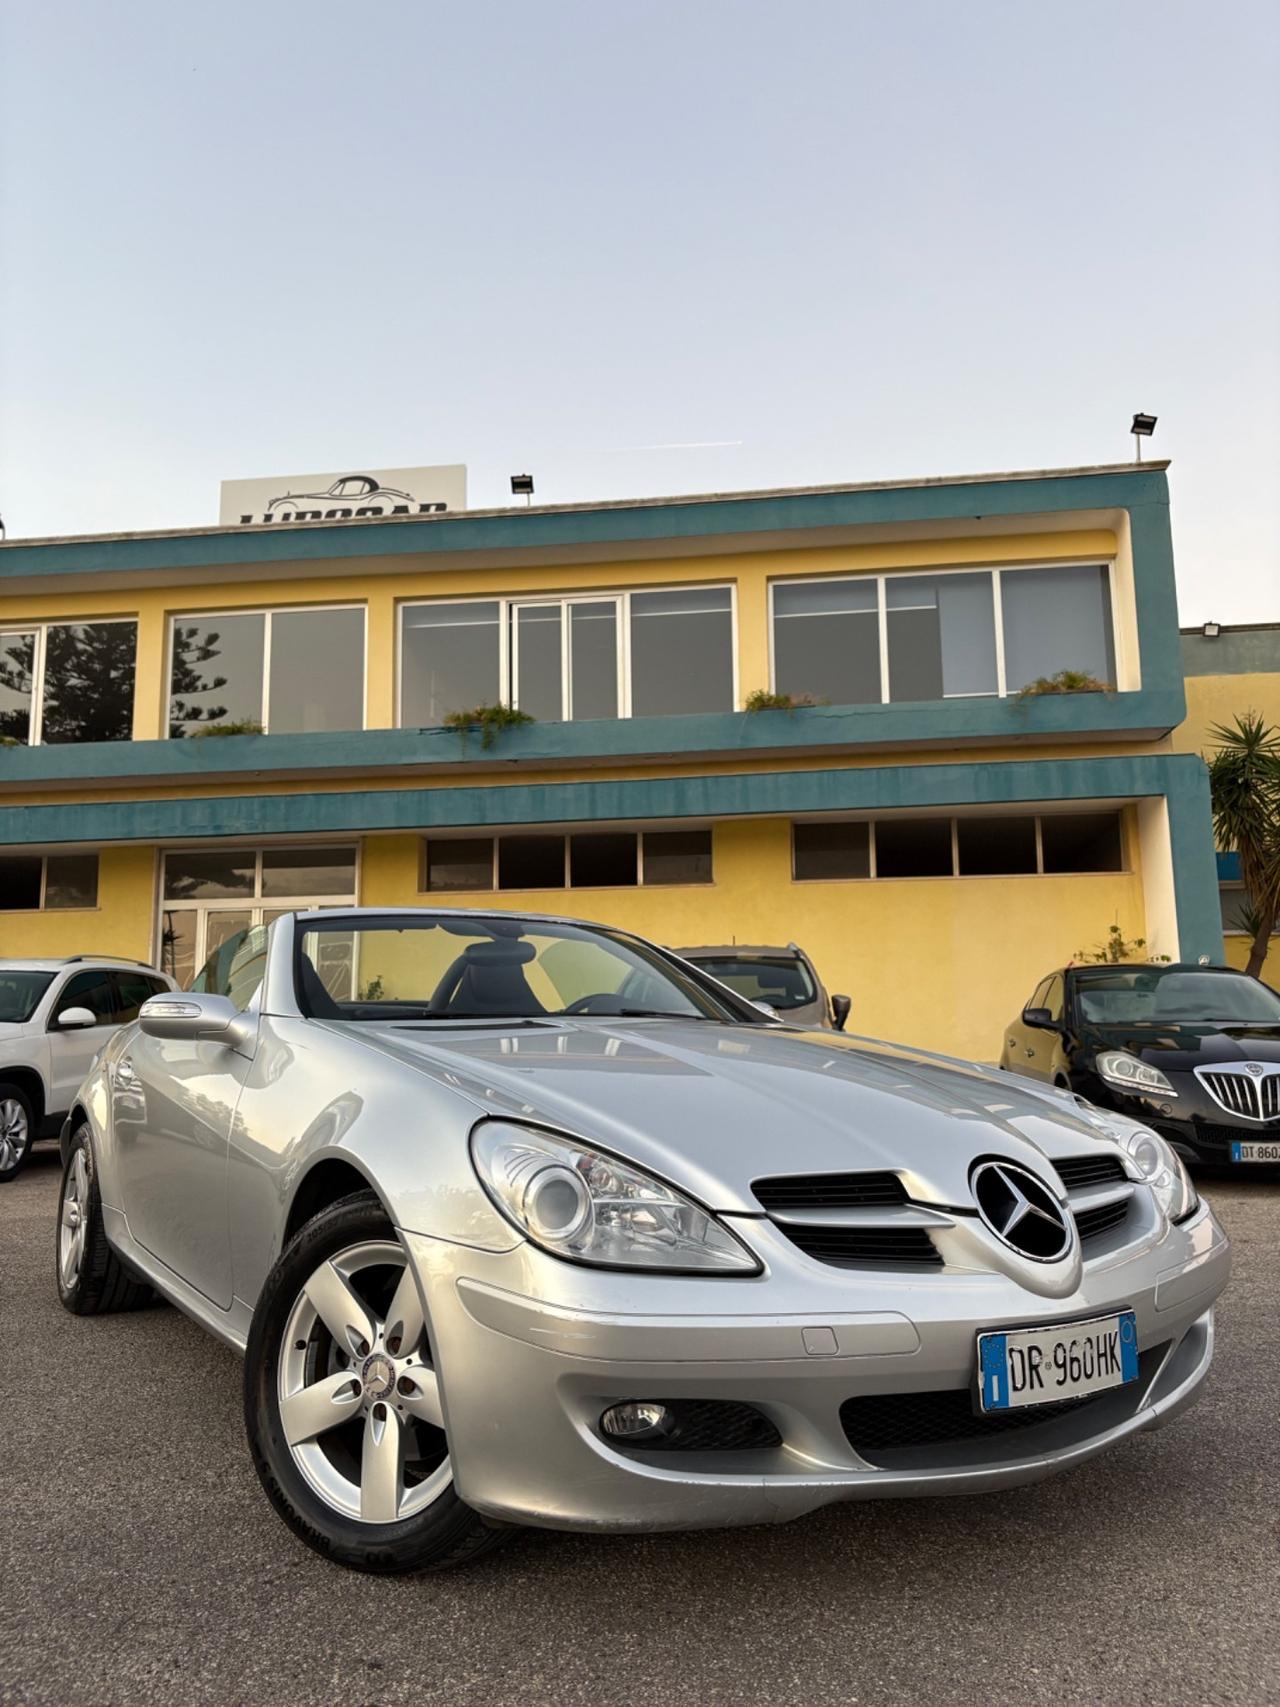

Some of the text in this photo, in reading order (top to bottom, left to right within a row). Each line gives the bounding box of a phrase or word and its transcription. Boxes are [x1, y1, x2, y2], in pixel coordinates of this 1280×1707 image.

[1241, 1145, 1254, 1158] DT
[1008, 1345, 1044, 1392] DR
[1053, 1331, 1121, 1386] 960HK
